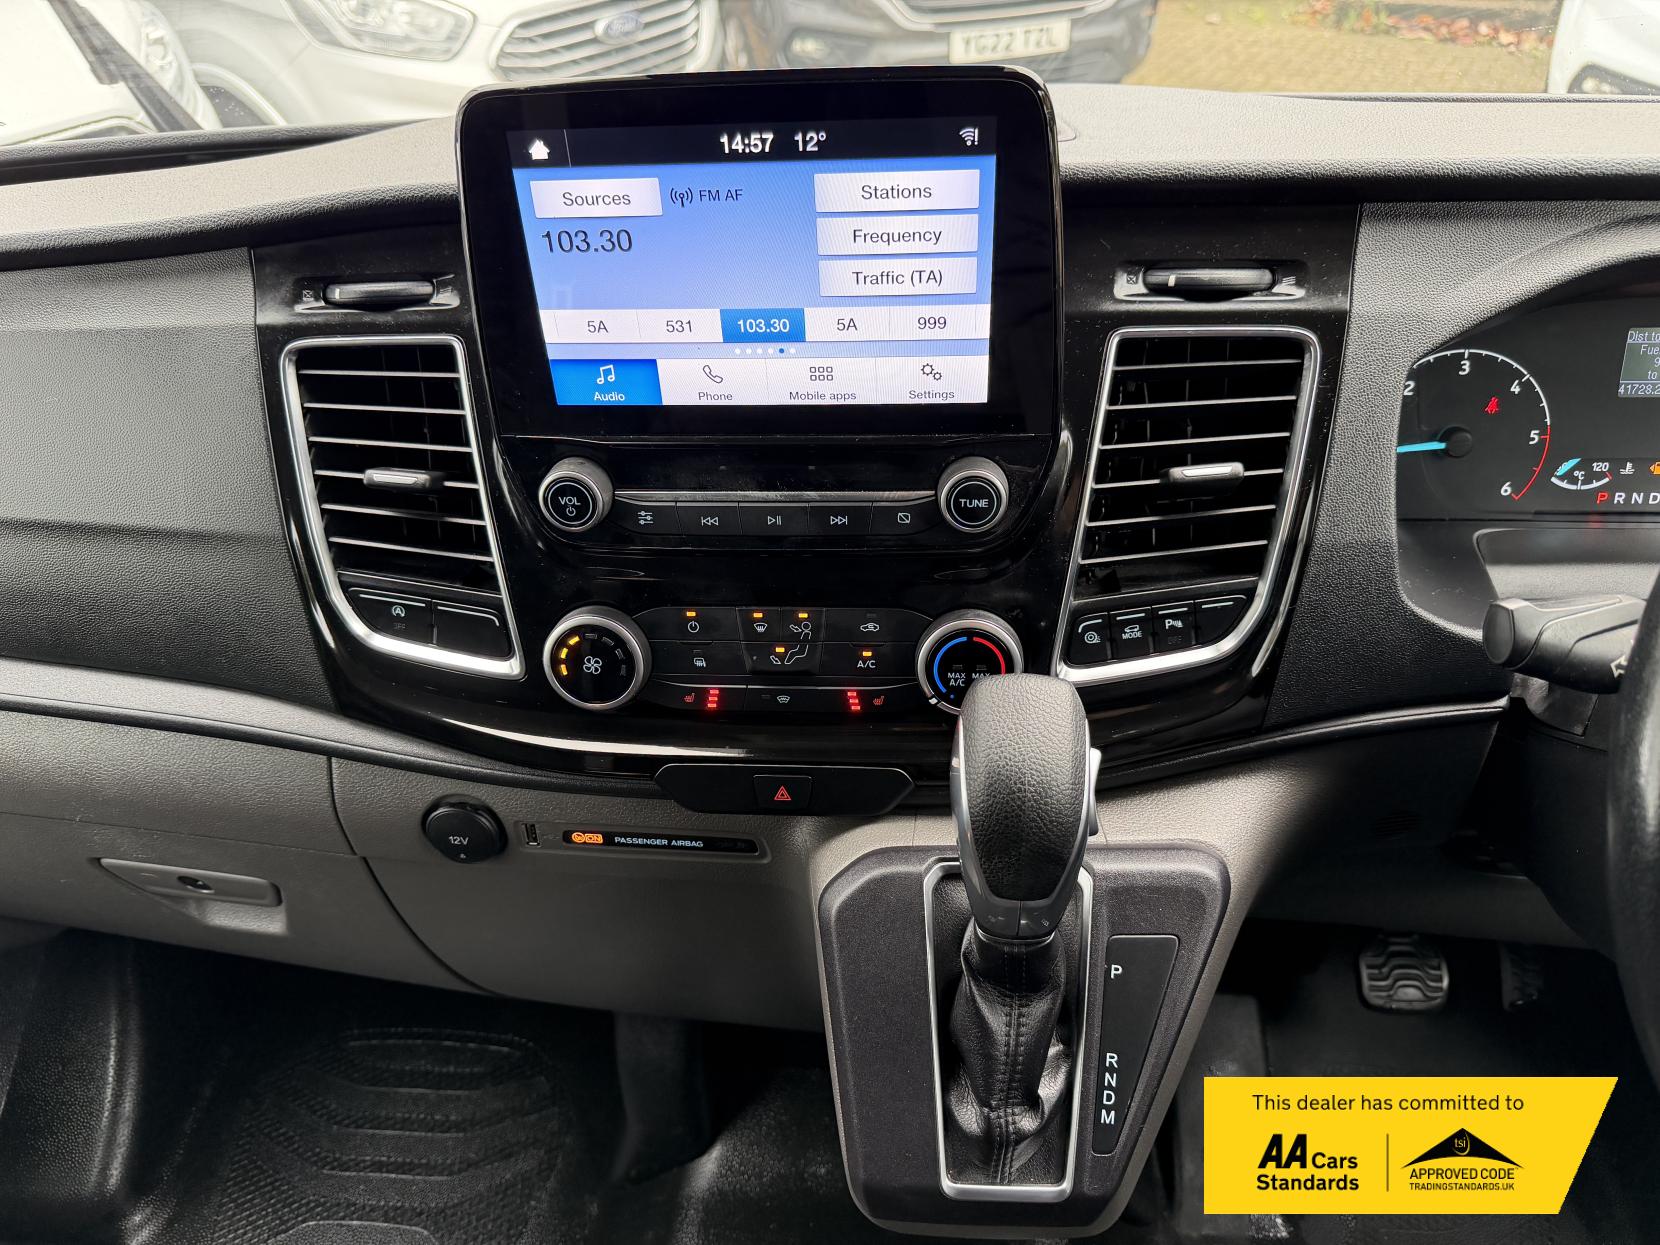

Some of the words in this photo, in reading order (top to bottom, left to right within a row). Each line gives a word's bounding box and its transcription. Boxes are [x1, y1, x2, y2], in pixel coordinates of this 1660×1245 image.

[720, 133, 774, 155] 14:57
[562, 190, 632, 208] Sources
[699, 189, 721, 202] FM
[725, 187, 744, 202] AF
[861, 183, 933, 201] Stations
[541, 229, 633, 254] 103.30
[852, 227, 943, 248] Frequency
[852, 269, 904, 286] Traffic
[910, 269, 943, 288] (TA)
[587, 320, 609, 335] 5A
[665, 318, 693, 334] 531
[737, 318, 790, 334] 103.30
[836, 316, 858, 332] 5A
[917, 315, 948, 331] 999
[1627, 331, 1648, 342] Dist
[1640, 344, 1660, 355] Fue
[1459, 361, 1471, 375] 3
[1647, 370, 1658, 380] to
[1404, 381, 1415, 395] 2
[1510, 379, 1521, 394] 4
[593, 391, 626, 403] Audio
[698, 391, 733, 402] Phone
[788, 390, 825, 402] Mobile
[828, 392, 857, 404] apps
[908, 389, 955, 402] Settings
[1528, 430, 1540, 444] 5
[1592, 462, 1609, 472] 120
[1500, 482, 1512, 496] 6
[558, 496, 581, 506] VOL
[959, 499, 989, 508] TUNE
[1596, 492, 1608, 504] P
[1613, 492, 1626, 504] R
[1631, 492, 1644, 504] N
[1122, 631, 1143, 640] MODE
[857, 660, 876, 669] A/C
[949, 679, 965, 687] A/C
[449, 836, 469, 846] 12V
[614, 836, 668, 846] PASSENGER
[670, 840, 704, 848] AIRBAG
[1111, 964, 1123, 979] P
[1106, 1053, 1118, 1068] R
[1104, 1072, 1117, 1087] N
[1102, 1090, 1115, 1105] D
[1100, 1109, 1115, 1124] M
